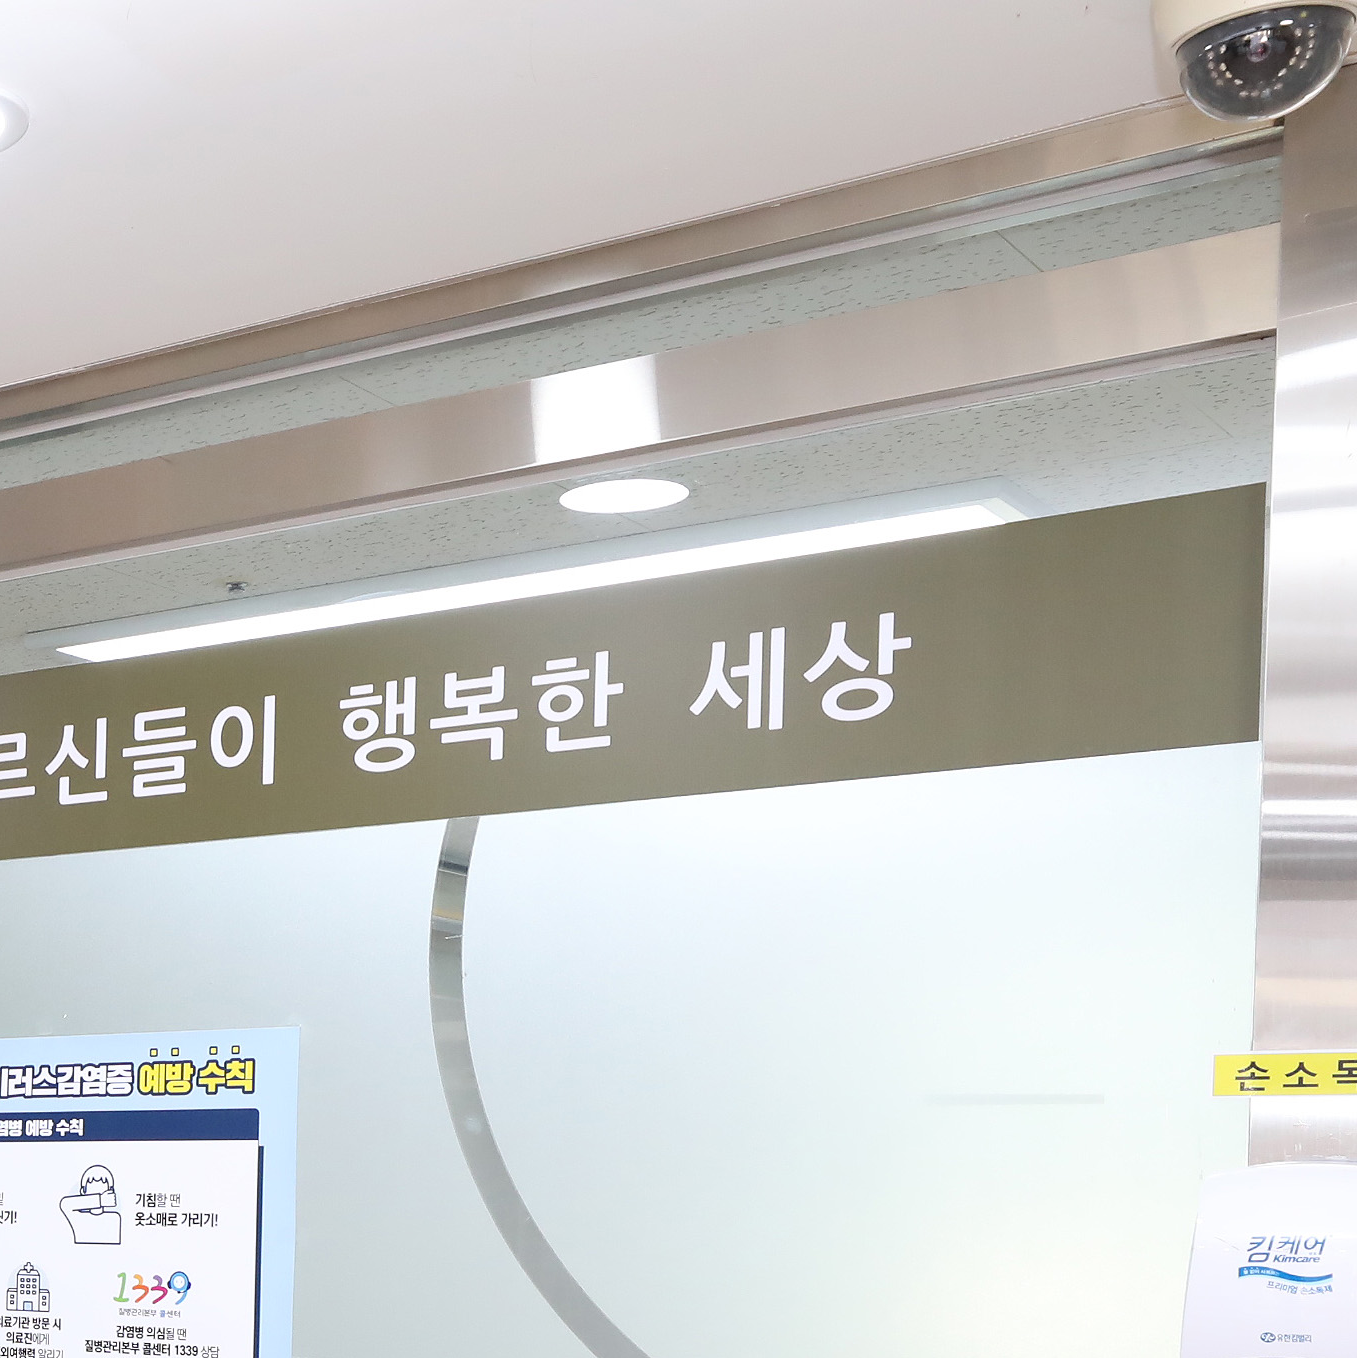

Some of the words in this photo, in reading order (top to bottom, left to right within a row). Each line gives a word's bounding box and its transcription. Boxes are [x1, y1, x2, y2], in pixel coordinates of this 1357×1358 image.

[339, 650, 624, 774] 행복한
[689, 611, 913, 731] 세상
[138, 1060, 195, 1096] 예방
[197, 1058, 255, 1095] 수칙
[25, 1119, 54, 1137] 예방
[56, 1118, 84, 1136] 수칙
[135, 1193, 168, 1208] 기침할
[169, 1193, 181, 1208] 땐
[135, 1212, 178, 1227] 옷소매로
[181, 1212, 219, 1228] 가리기!
[1247, 1235, 1327, 1263] 킴케어
[1273, 1254, 1321, 1263] Kimcare
[1266, 1280, 1298, 1294] 프리미엄
[32, 1317, 51, 1330] 방문
[53, 1318, 62, 1330] 시
[6, 1331, 50, 1345] 의료진에게
[116, 1326, 144, 1340] 감염병
[147, 1326, 175, 1340] 의심될
[177, 1328, 187, 1341] 땐
[85, 1339, 140, 1355] 질병관리본부
[143, 1342, 171, 1356] 콜센터
[175, 1344, 199, 1356] 1339
[201, 1345, 221, 1358] 상담
